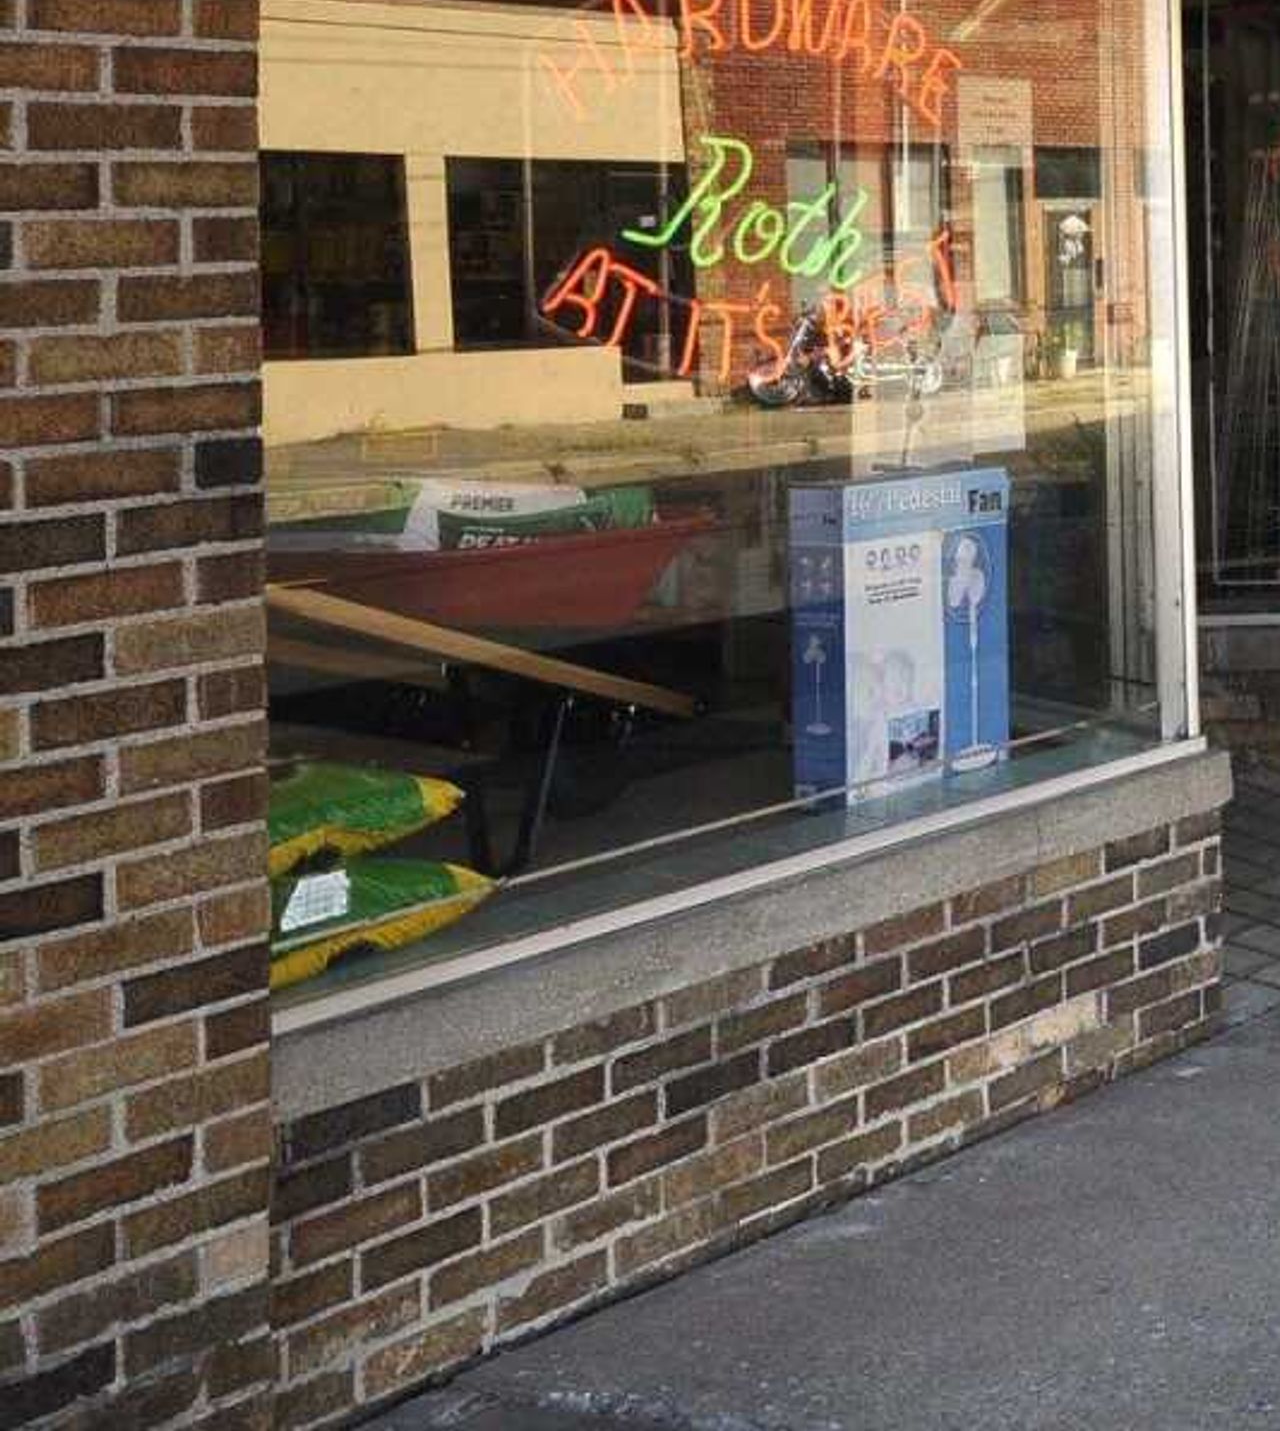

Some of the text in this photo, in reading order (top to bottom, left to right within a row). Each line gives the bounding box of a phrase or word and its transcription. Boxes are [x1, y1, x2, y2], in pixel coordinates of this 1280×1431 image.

[621, 135, 869, 290] Roth
[541, 247, 661, 350] AT
[677, 281, 787, 382] IT'S
[967, 489, 1003, 513] Fan
